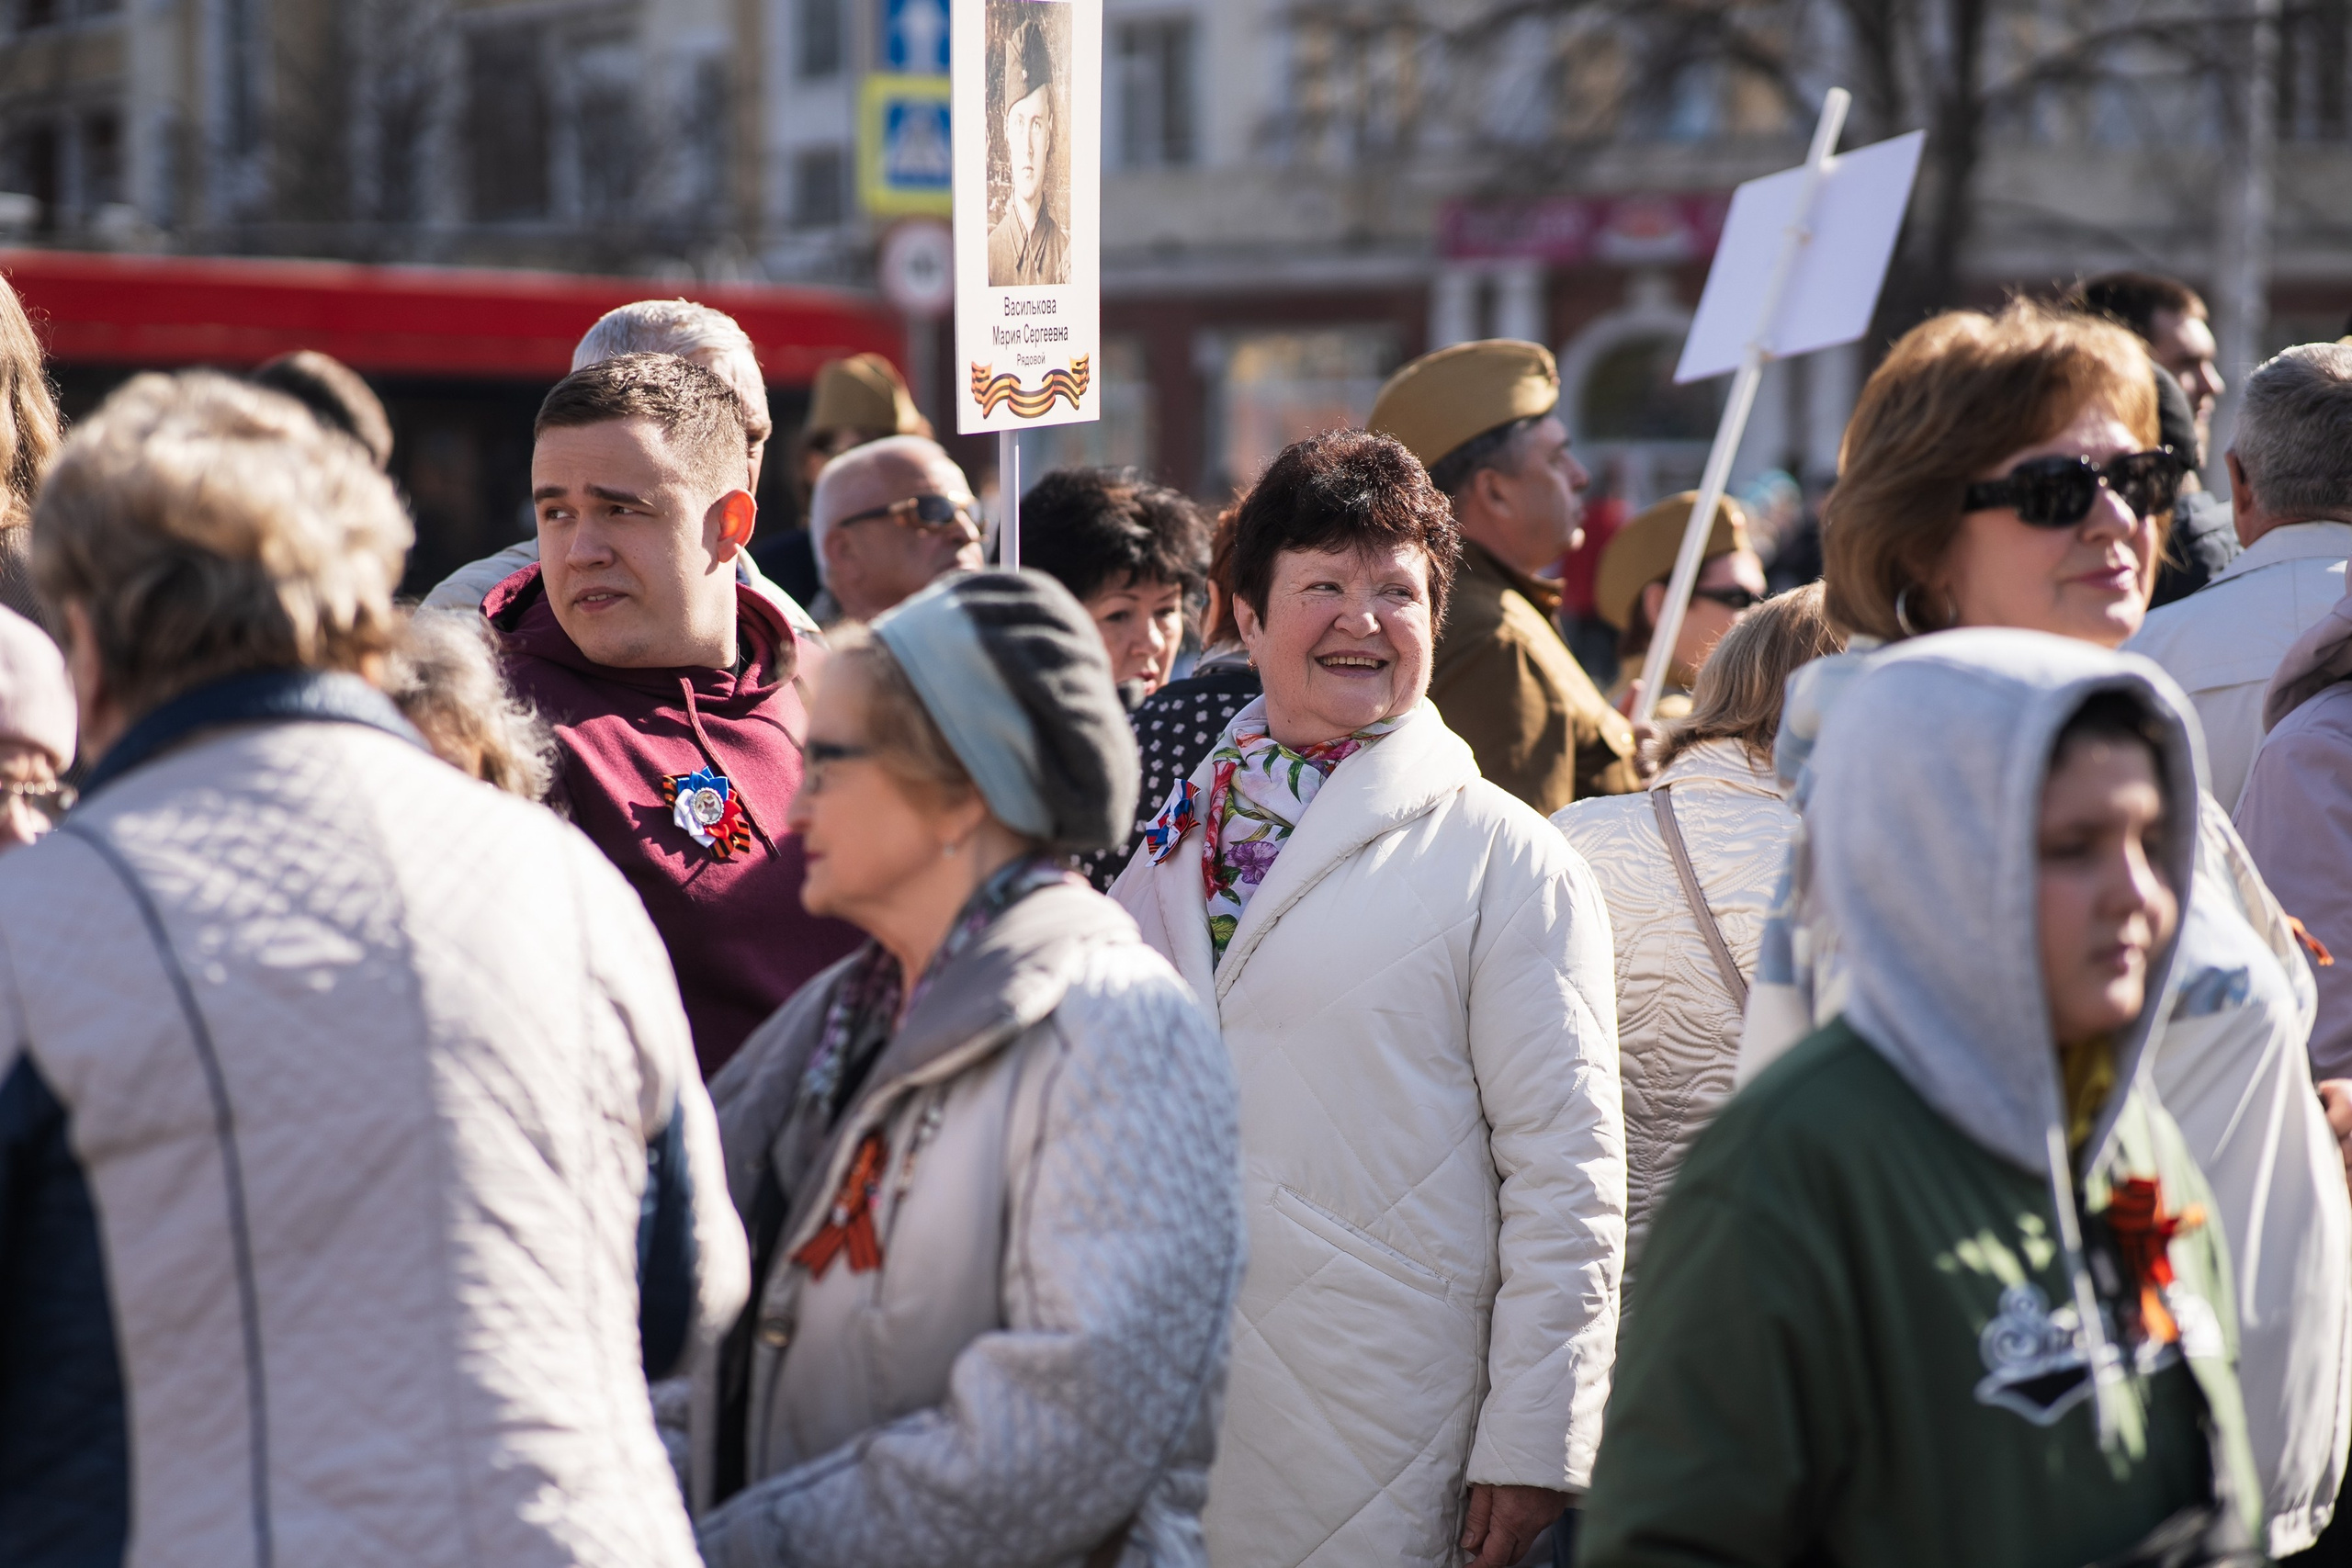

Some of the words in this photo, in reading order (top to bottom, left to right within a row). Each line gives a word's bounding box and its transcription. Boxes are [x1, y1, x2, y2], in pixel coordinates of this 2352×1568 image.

[1004, 297, 1057, 316] Василькова
[993, 325, 1021, 350] Мария
[1023, 323, 1069, 348] Сергеевна
[1017, 352, 1046, 367] Рядовой
